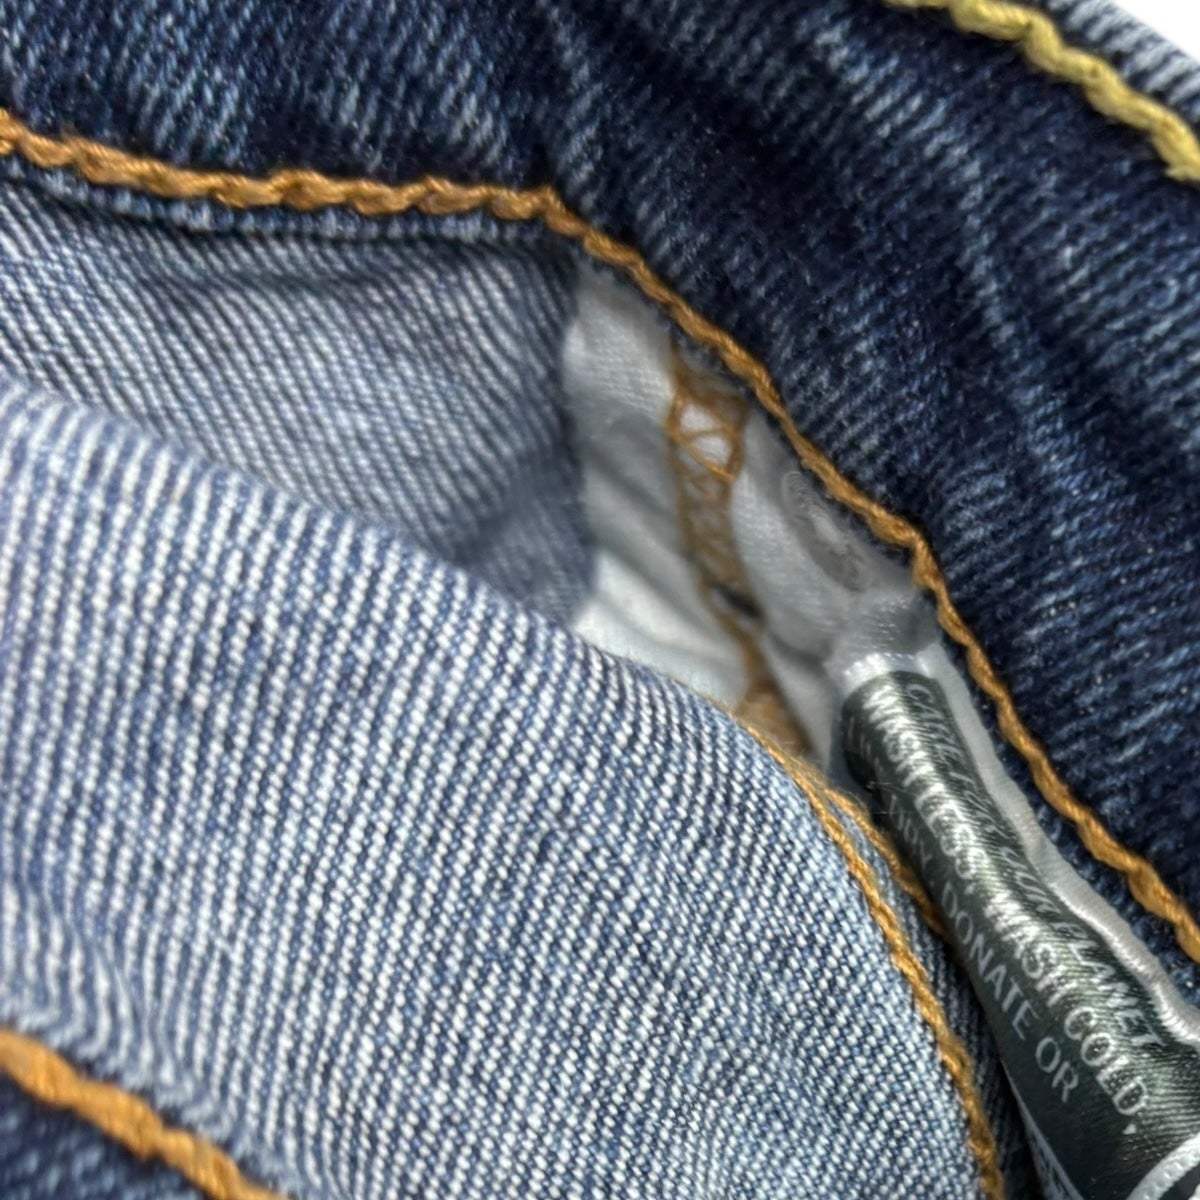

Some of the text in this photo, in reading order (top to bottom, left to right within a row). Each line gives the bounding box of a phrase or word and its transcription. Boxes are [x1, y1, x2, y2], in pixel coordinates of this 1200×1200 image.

[857, 681, 937, 788] WASH
[978, 886, 1079, 1008] WASH
[932, 878, 1045, 1041] DONATE
[1028, 1033, 1087, 1104] OR
